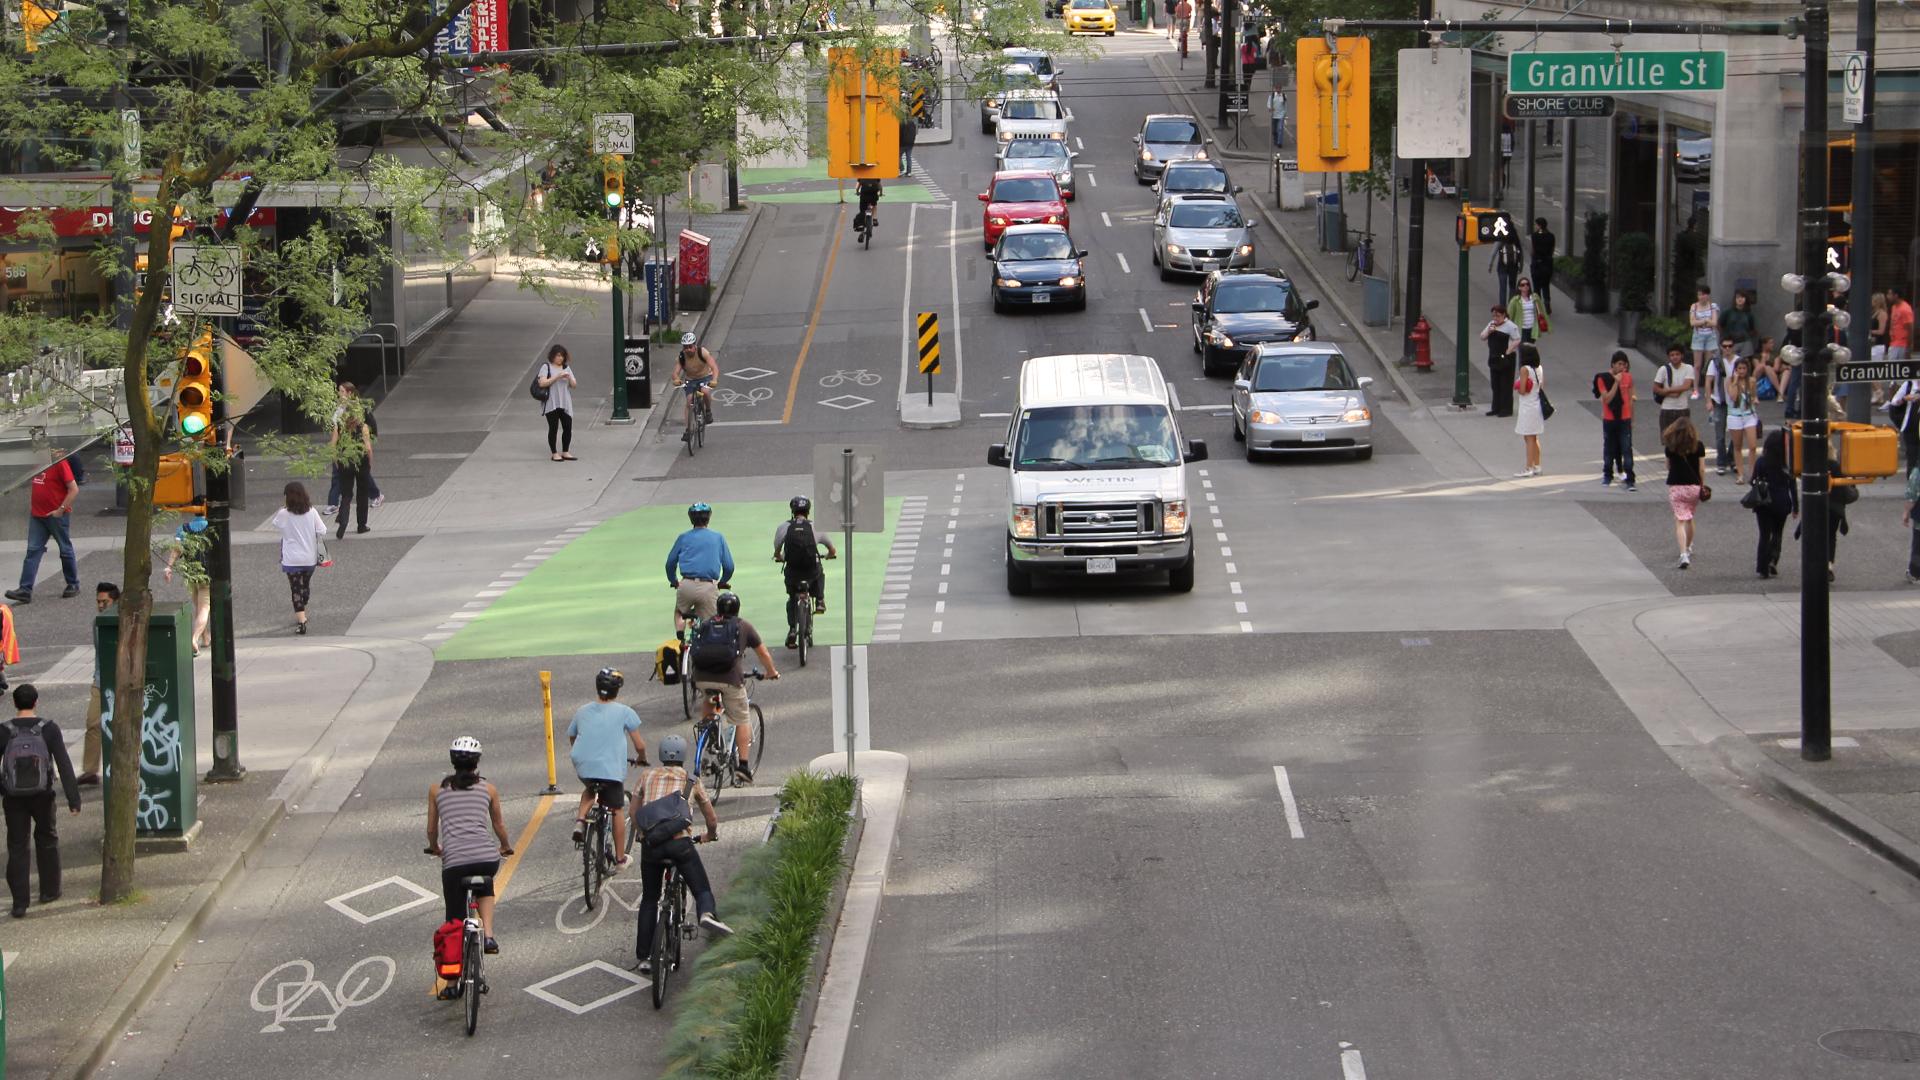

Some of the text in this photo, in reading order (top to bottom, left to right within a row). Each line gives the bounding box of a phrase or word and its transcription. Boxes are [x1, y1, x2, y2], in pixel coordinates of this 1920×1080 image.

[1528, 58, 1707, 86] Granville St
[1517, 98, 1604, 110] SHORE CLUB
[181, 293, 234, 306] SIGNAL
[1840, 363, 1911, 380] Granville
